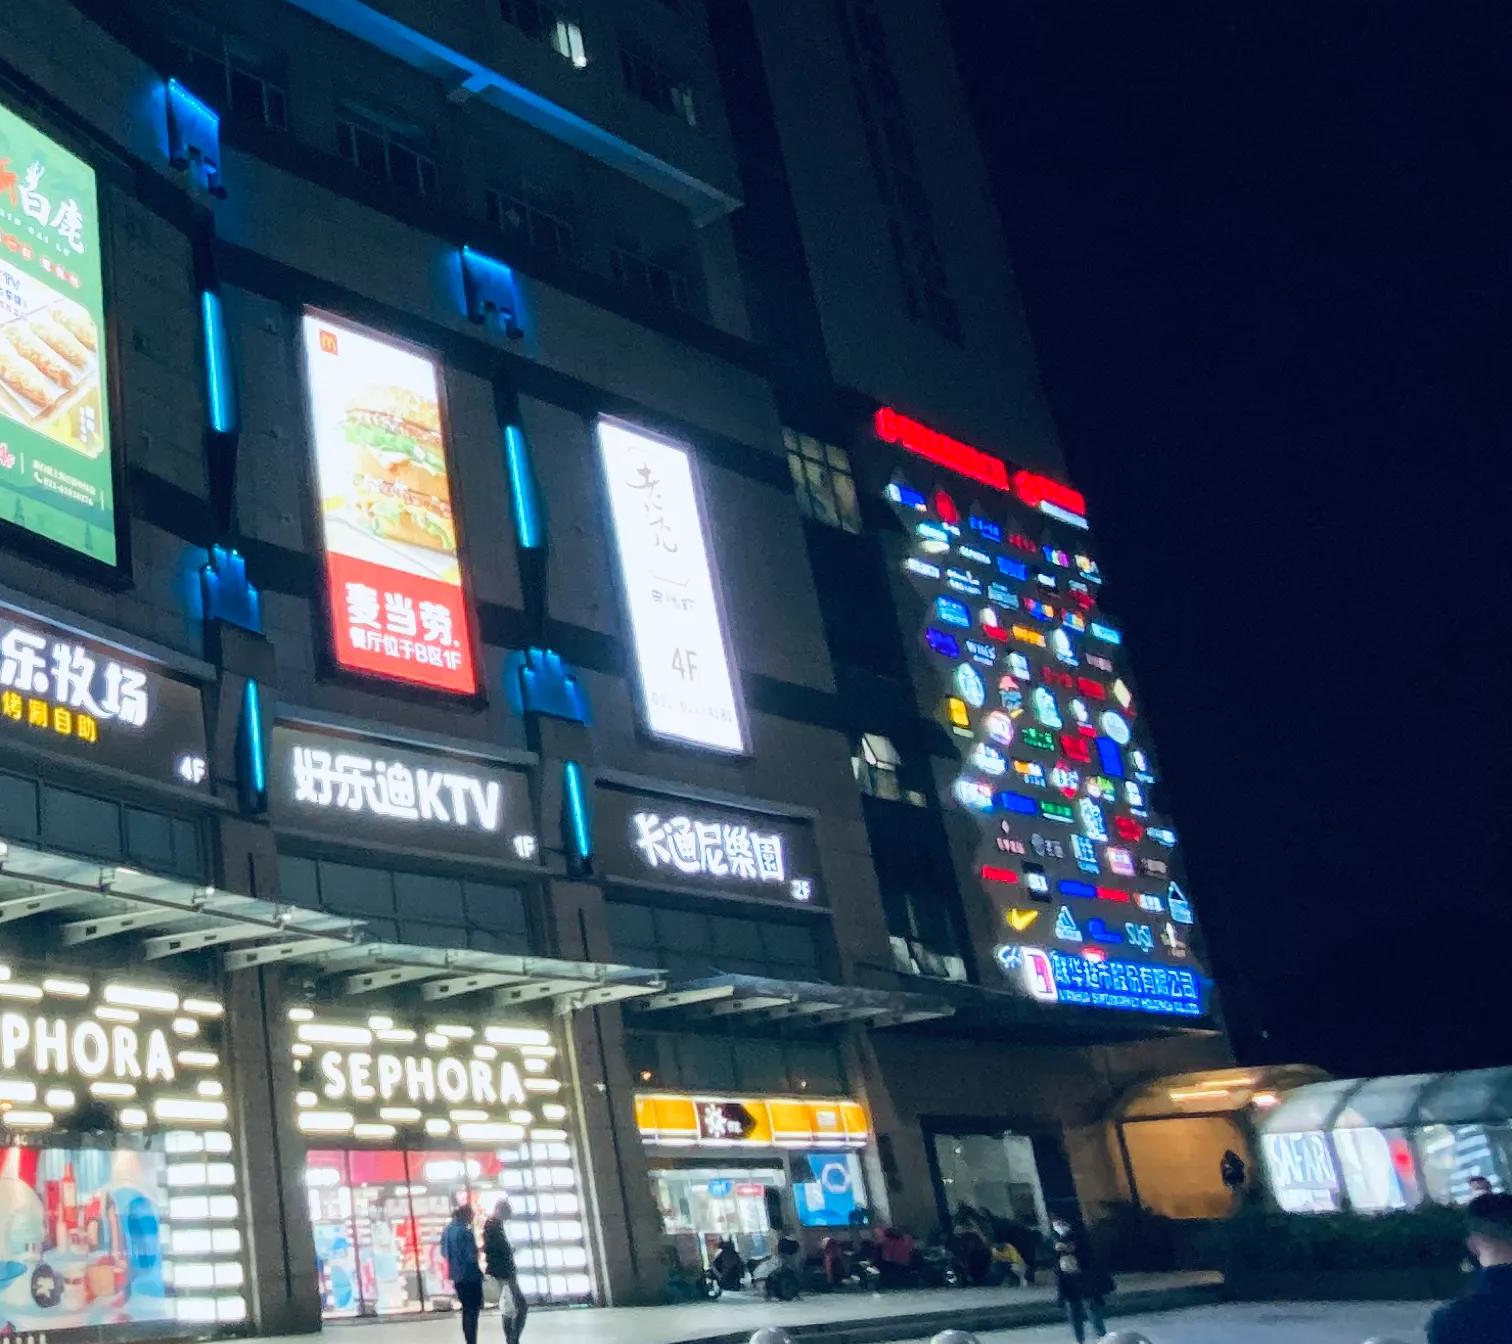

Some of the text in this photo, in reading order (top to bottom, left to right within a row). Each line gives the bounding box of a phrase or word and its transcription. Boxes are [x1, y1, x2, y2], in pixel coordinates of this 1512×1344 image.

[345, 582, 454, 646] 麦当劳
[671, 647, 698, 683] 4F
[180, 756, 207, 784] 4F
[292, 746, 501, 832] 好乐迪KTV
[320, 1051, 527, 1105] SEPHORA
